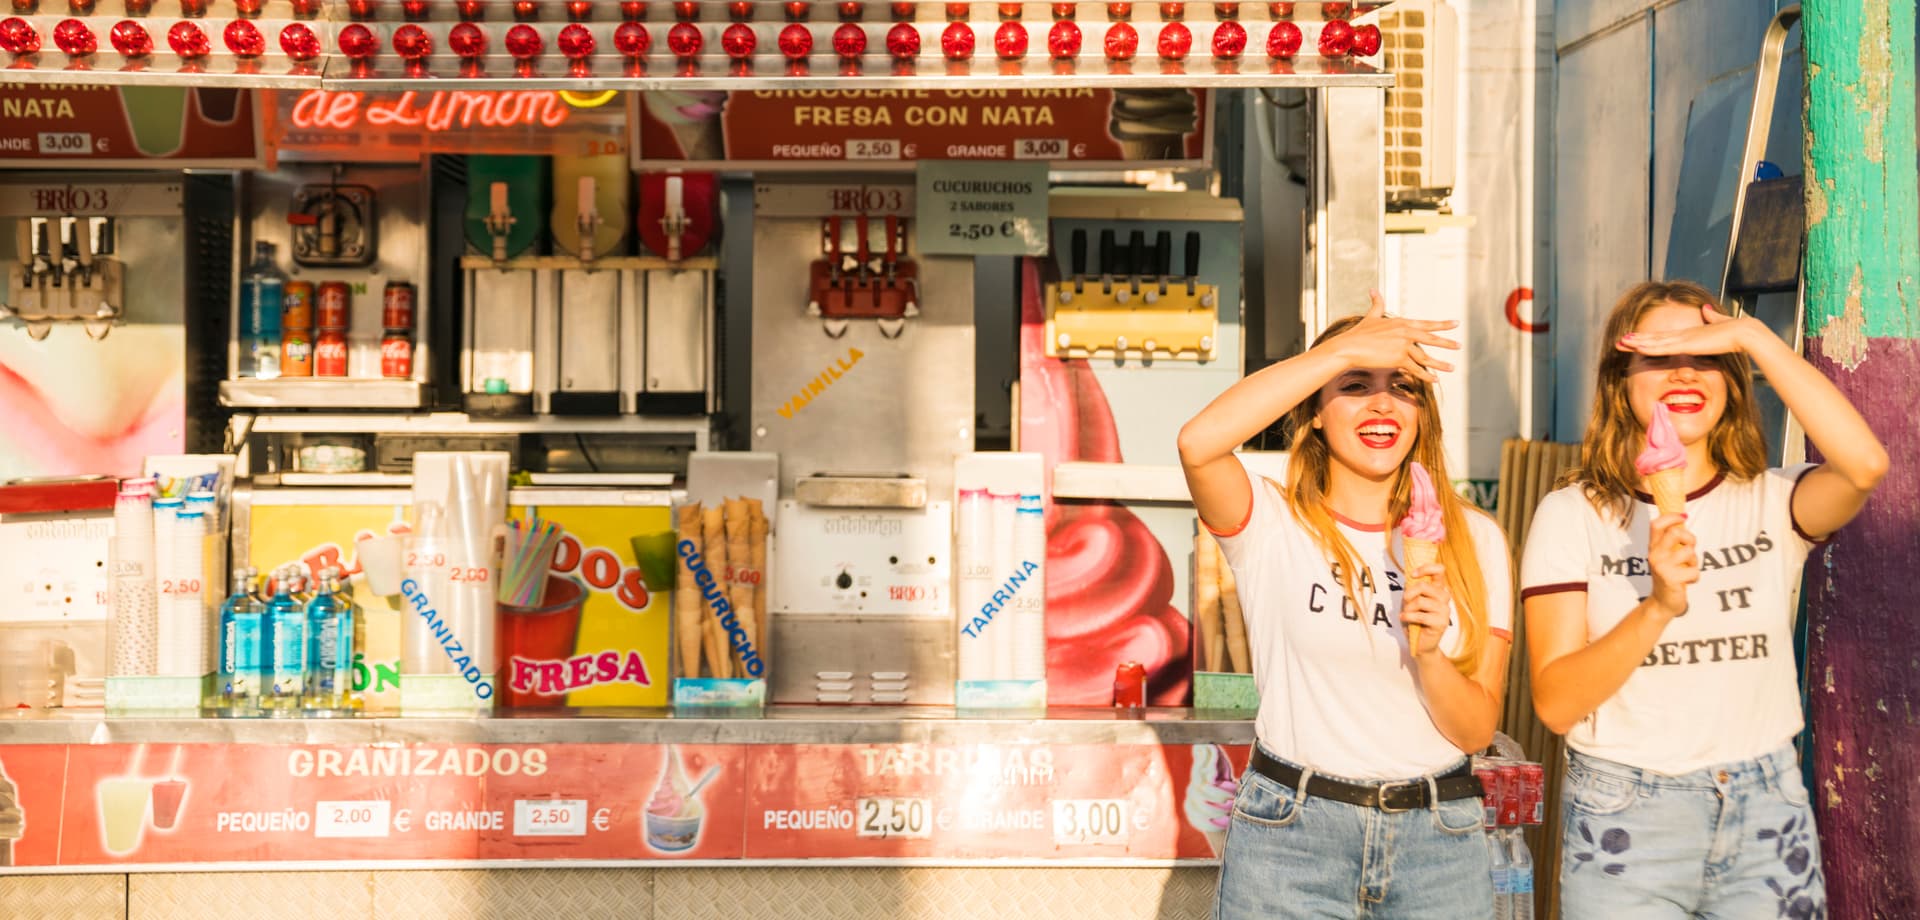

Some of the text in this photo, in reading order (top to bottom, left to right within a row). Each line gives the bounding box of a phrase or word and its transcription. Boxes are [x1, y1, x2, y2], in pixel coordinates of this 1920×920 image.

[3, 97, 75, 118] NATA
[794, 105, 1055, 126] FRESA CON NATA
[45, 135, 83, 150] 3,00
[96, 137, 110, 152] €
[772, 141, 1087, 159] PEQUEÑO 2,50 € GRANDE 3,00 €
[932, 180, 1033, 195] CUCURUCHOS
[93, 188, 108, 211] 3
[887, 188, 903, 211] 3
[949, 201, 1015, 212] 2 SABORES
[949, 220, 1015, 240] 2,50 €
[776, 347, 865, 420] VAINILLA
[1600, 530, 1774, 577] MEAIDS
[450, 566, 489, 583] 2,00
[723, 566, 762, 586] 3,00
[1331, 562, 1404, 594] EAS
[162, 579, 201, 595] 2,50
[677, 539, 766, 678] CUCURUCHO
[960, 560, 1039, 639] TARRINA
[1716, 586, 1753, 612] IT
[400, 578, 494, 700] GRANIZADO
[512, 651, 651, 693] FRESA
[288, 747, 548, 777] GRANIZADOS
[217, 807, 611, 833] PEQUEÑO 2,00 € GRANDE 2,50 €
[764, 805, 854, 830] PEQUEÑO
[864, 799, 924, 839] 2,50
[1062, 801, 1122, 842] 3,00
[1131, 807, 1152, 831] €
